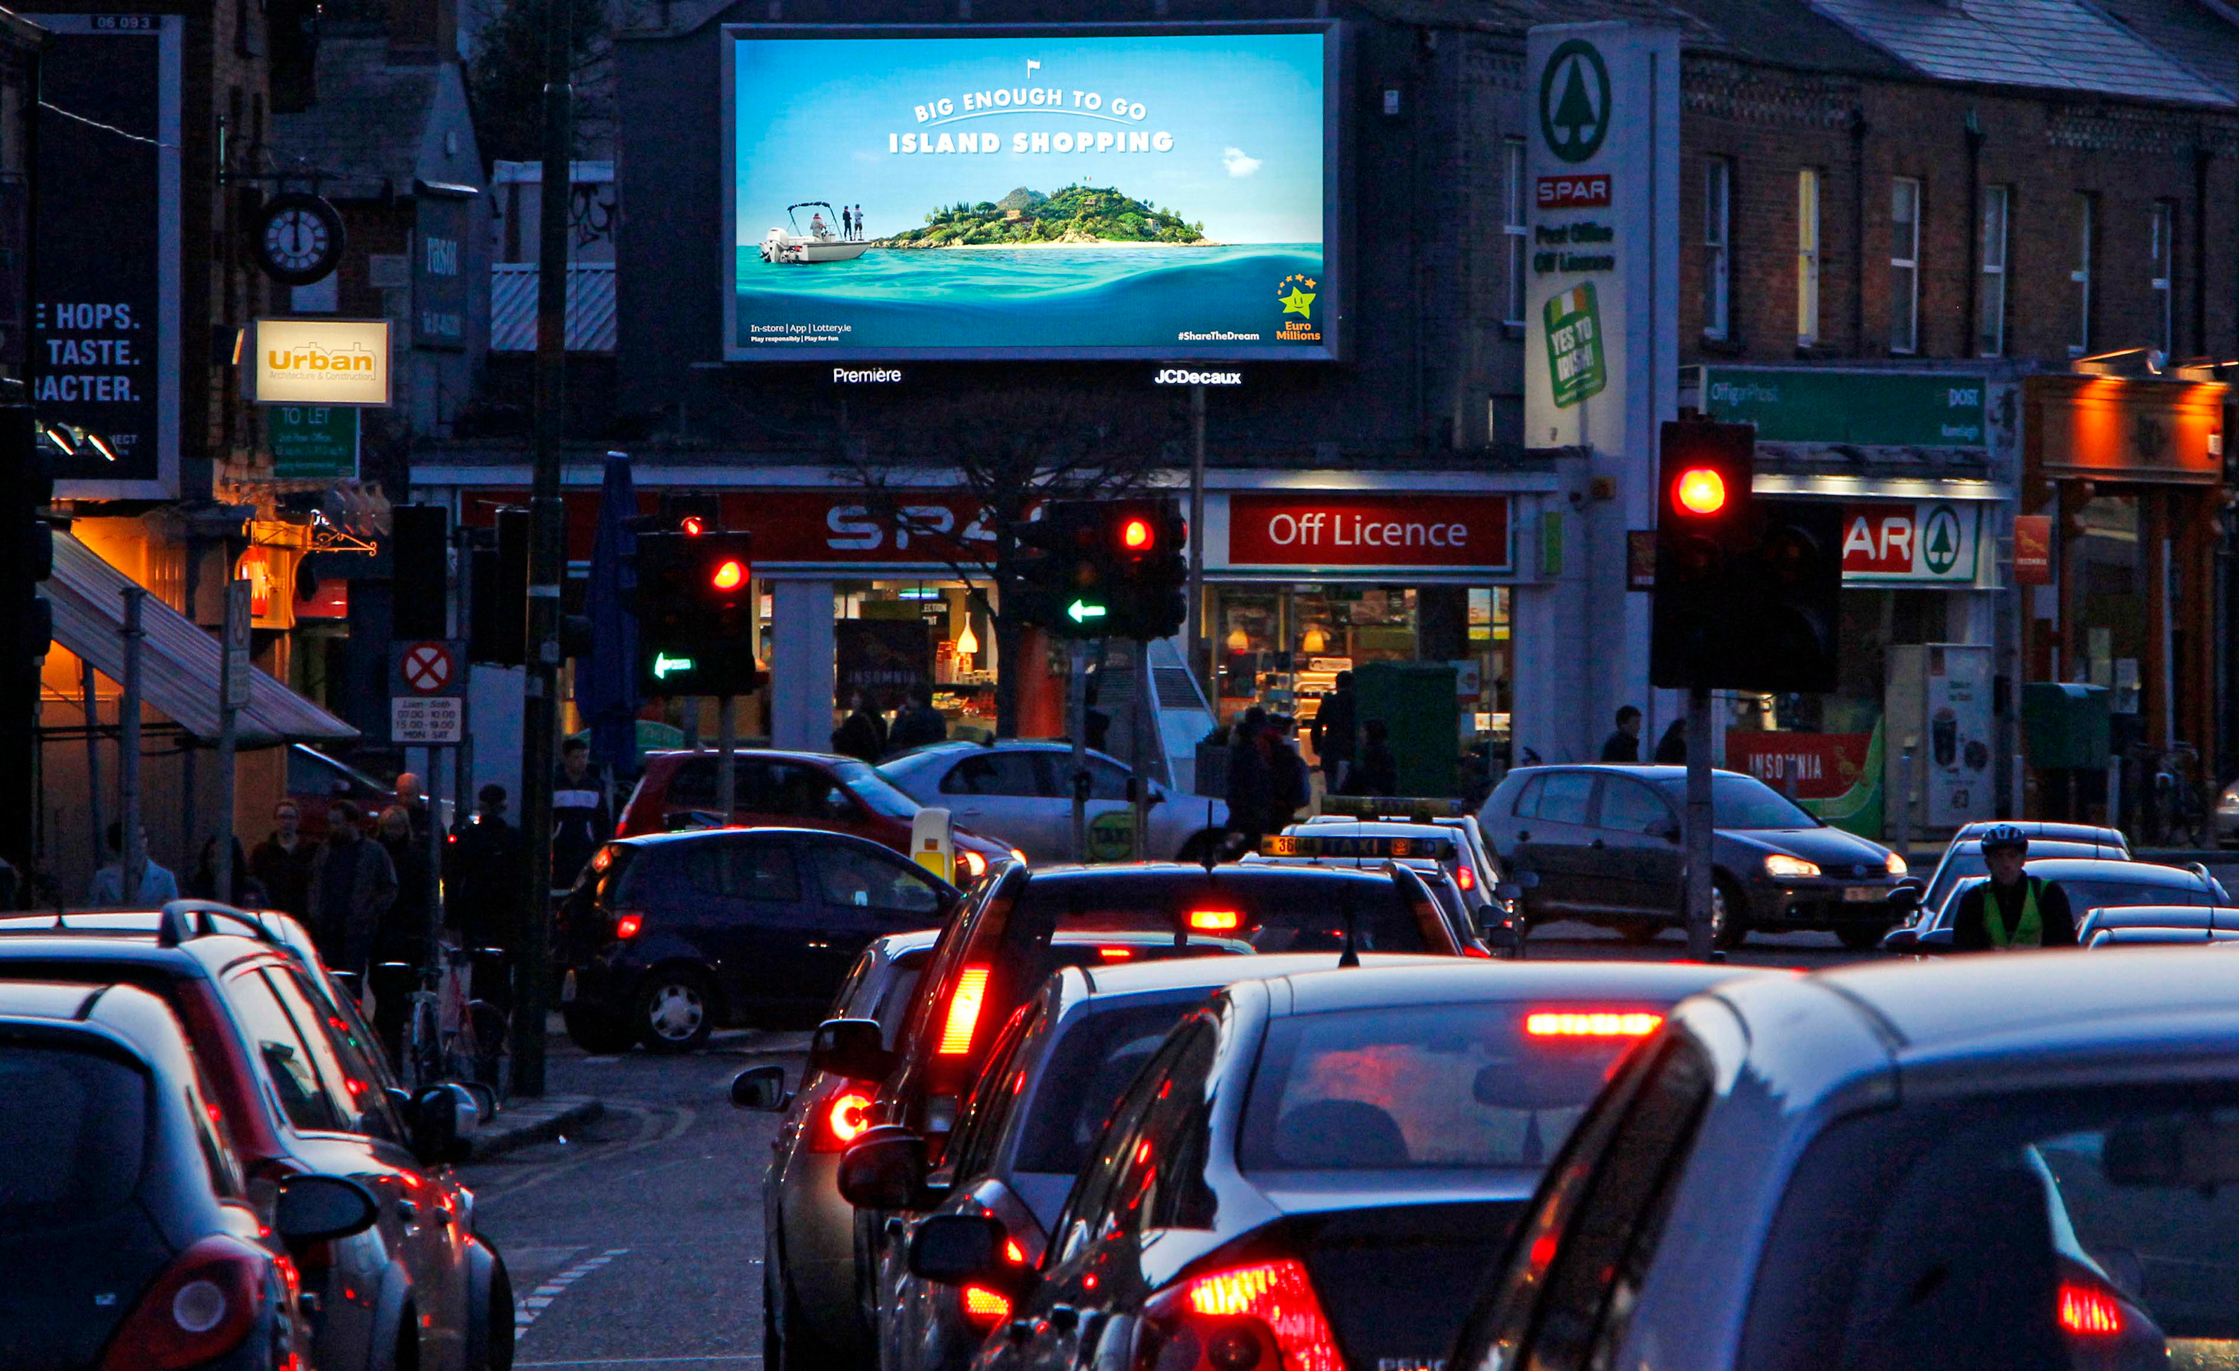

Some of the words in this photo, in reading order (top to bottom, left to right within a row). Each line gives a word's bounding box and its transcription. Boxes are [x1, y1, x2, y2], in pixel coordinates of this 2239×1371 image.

[914, 98, 954, 123] BIG
[963, 87, 1062, 111] ENOUGH
[1073, 90, 1102, 111] TO
[1111, 98, 1147, 121] GO
[889, 132, 1000, 154] ISLAND
[1012, 131, 1174, 153] SHOPPING
[1538, 180, 1606, 201] SPAR
[56, 302, 141, 330] HOPS.
[1285, 321, 1312, 331] Euro
[751, 324, 784, 333] In-store
[789, 324, 807, 334] App
[812, 324, 852, 334] Lottery.ie
[804, 335, 818, 343] Play
[1178, 331, 1259, 340] #ShareTheDream
[1276, 330, 1321, 340] Millions
[1551, 325, 1575, 356] YES
[1576, 316, 1593, 343] TO
[46, 339, 141, 366] TASTE.
[268, 350, 373, 371] Urban
[269, 371, 316, 380] Architecture
[325, 371, 373, 381] Construction
[833, 367, 902, 383] Première
[1154, 369, 1242, 384] JCDecaux
[281, 407, 301, 425] TO
[308, 407, 331, 424] LET
[826, 505, 1010, 550] SPA
[1268, 512, 1326, 546] Off
[1334, 514, 1468, 547] Licence
[1842, 516, 1913, 560] AR
